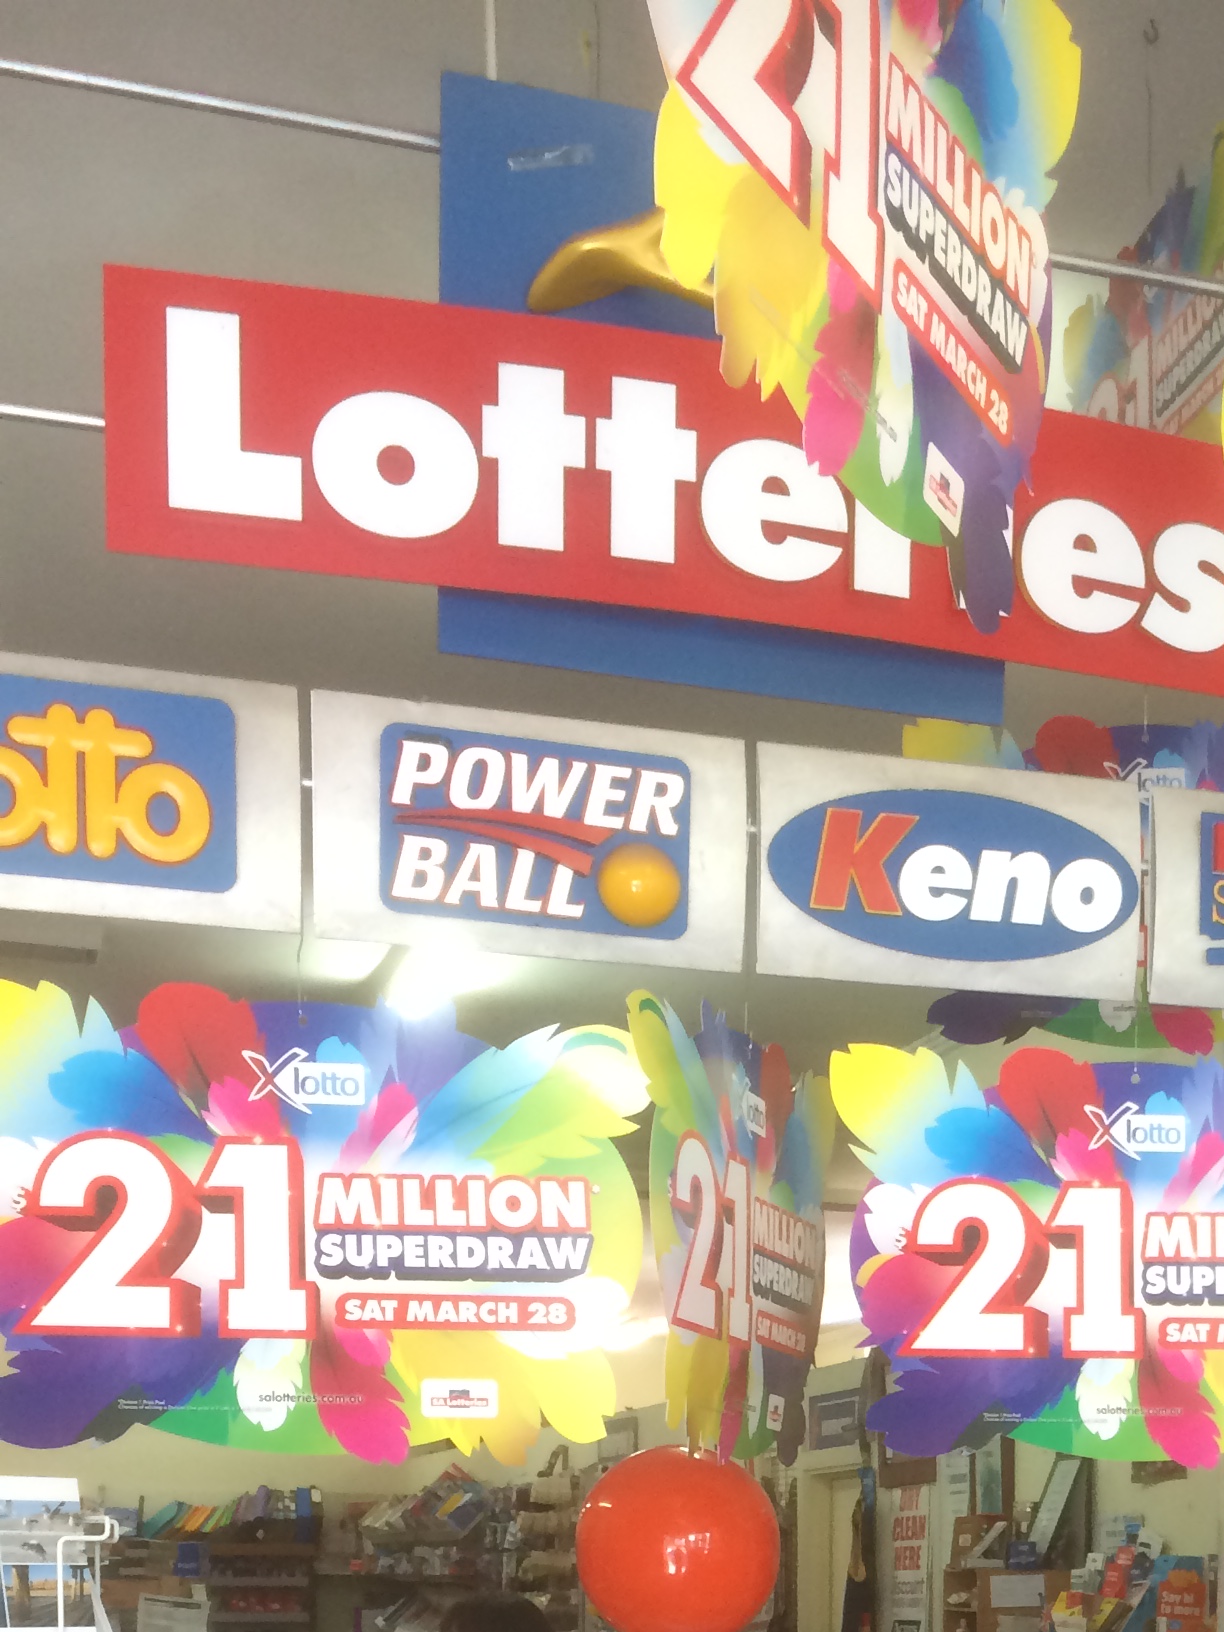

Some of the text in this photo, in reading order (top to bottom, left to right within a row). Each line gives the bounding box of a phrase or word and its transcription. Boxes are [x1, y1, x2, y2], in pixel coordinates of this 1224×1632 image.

[886, 53, 1035, 312] MILLION
[885, 152, 1028, 366] SUPERDRAW
[896, 269, 1009, 434] SAT MARCH 28
[390, 737, 685, 837] POWER
[390, 833, 587, 918] BALL
[809, 806, 1123, 933] Keno
[315, 1174, 592, 1232] MILLION
[317, 1232, 592, 1270] SUPERDRAW
[344, 1299, 568, 1325] SAT MARCH 28
[1166, 1323, 1209, 1343] SAT
[258, 1389, 363, 1405] salotteries.com.au
